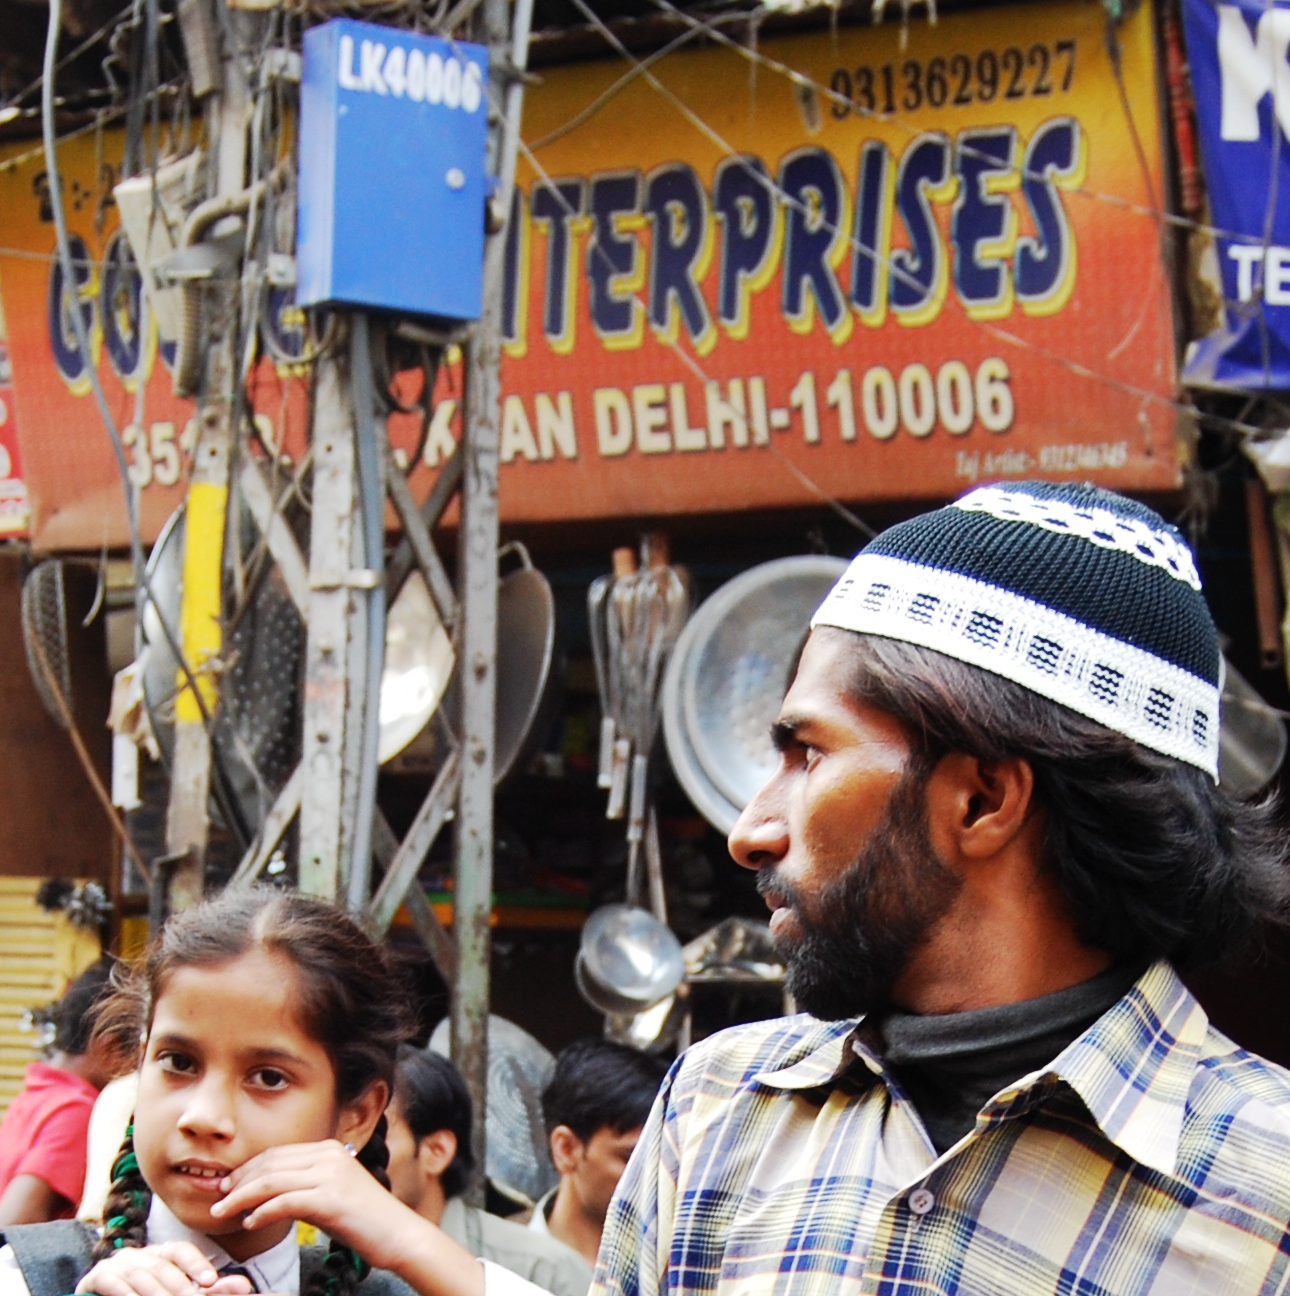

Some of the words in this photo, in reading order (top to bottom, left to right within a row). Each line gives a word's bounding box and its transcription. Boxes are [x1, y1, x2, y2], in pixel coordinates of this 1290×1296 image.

[338, 34, 482, 114] LK40006
[830, 39, 1077, 118] 9313629227
[499, 115, 1088, 358] TERPRISES
[423, 390, 576, 468] KAN
[595, 355, 1014, 456] DELHI-110006
